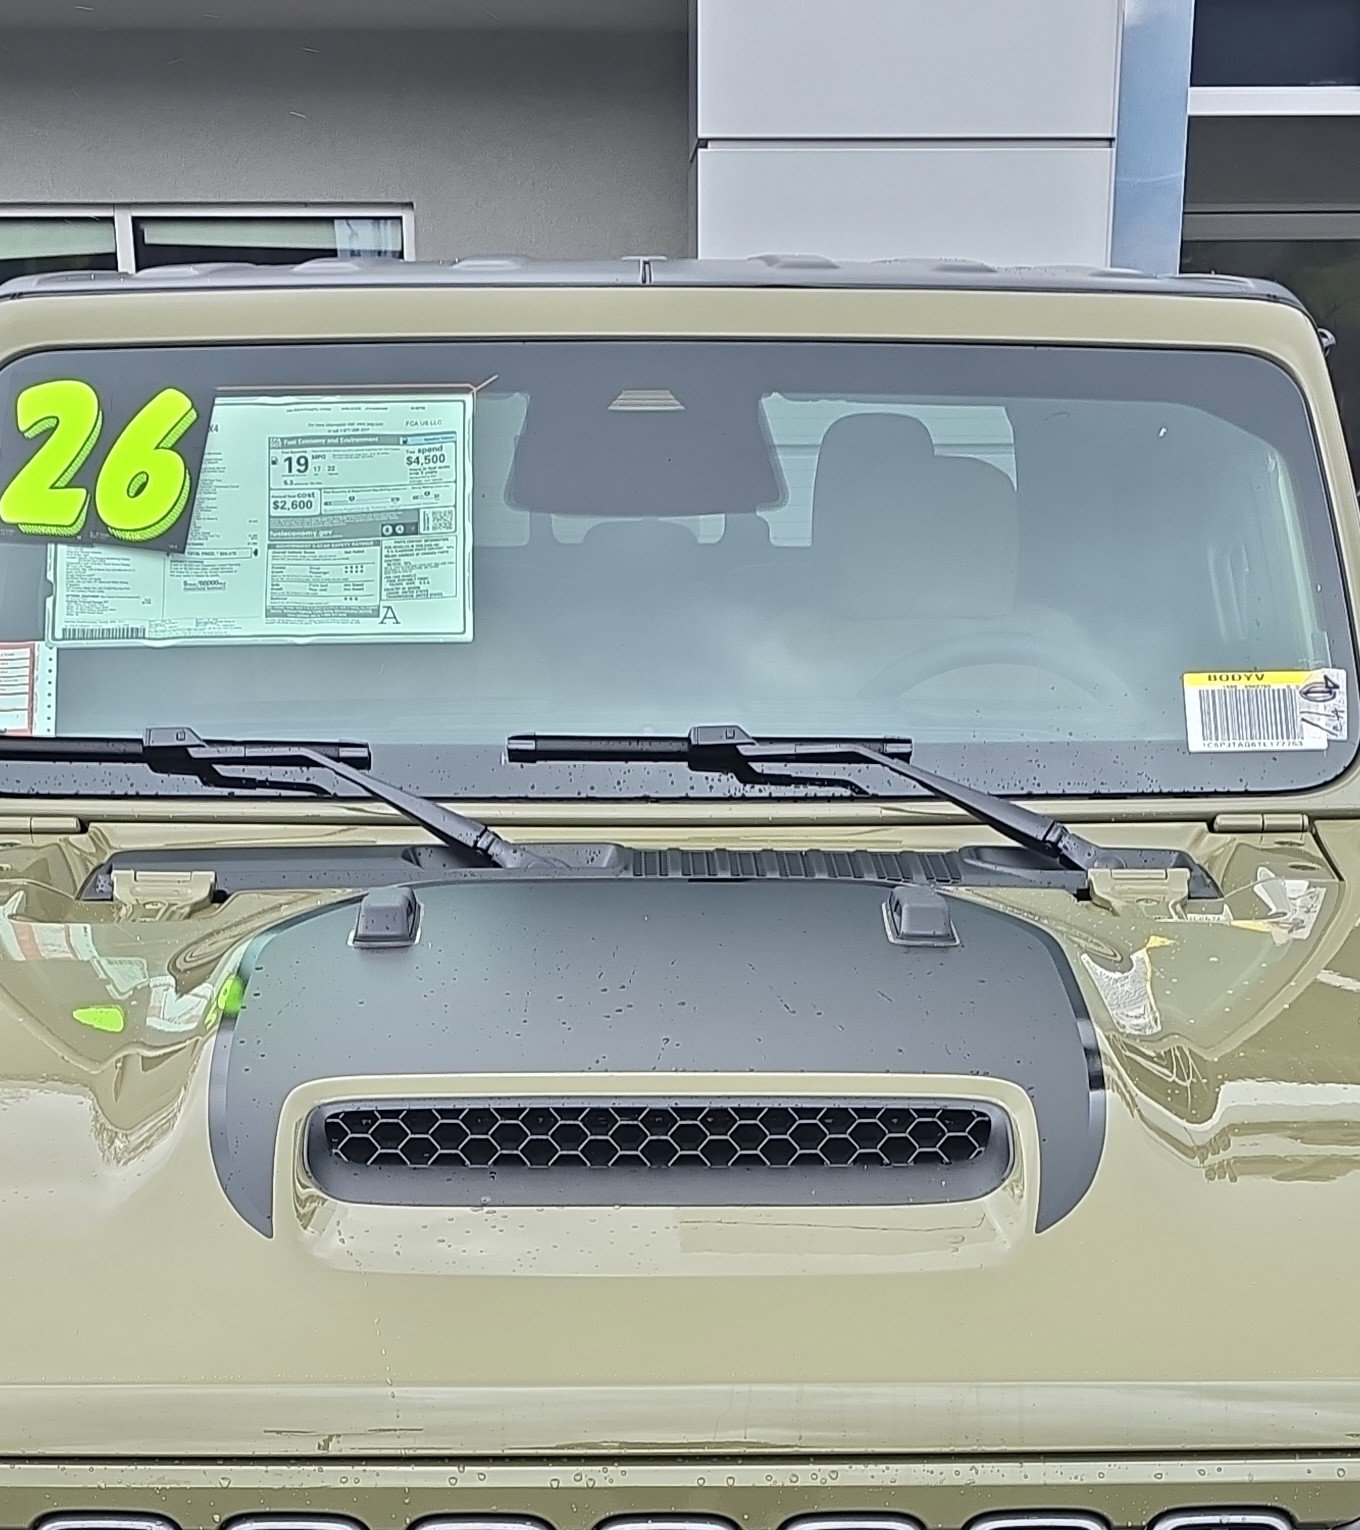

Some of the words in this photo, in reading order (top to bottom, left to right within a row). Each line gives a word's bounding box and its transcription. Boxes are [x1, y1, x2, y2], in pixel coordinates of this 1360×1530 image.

[417, 445, 443, 456] spend
[283, 455, 309, 474] 19
[405, 453, 445, 467] $4,500
[272, 500, 313, 511] $2,600
[378, 605, 401, 625] A
